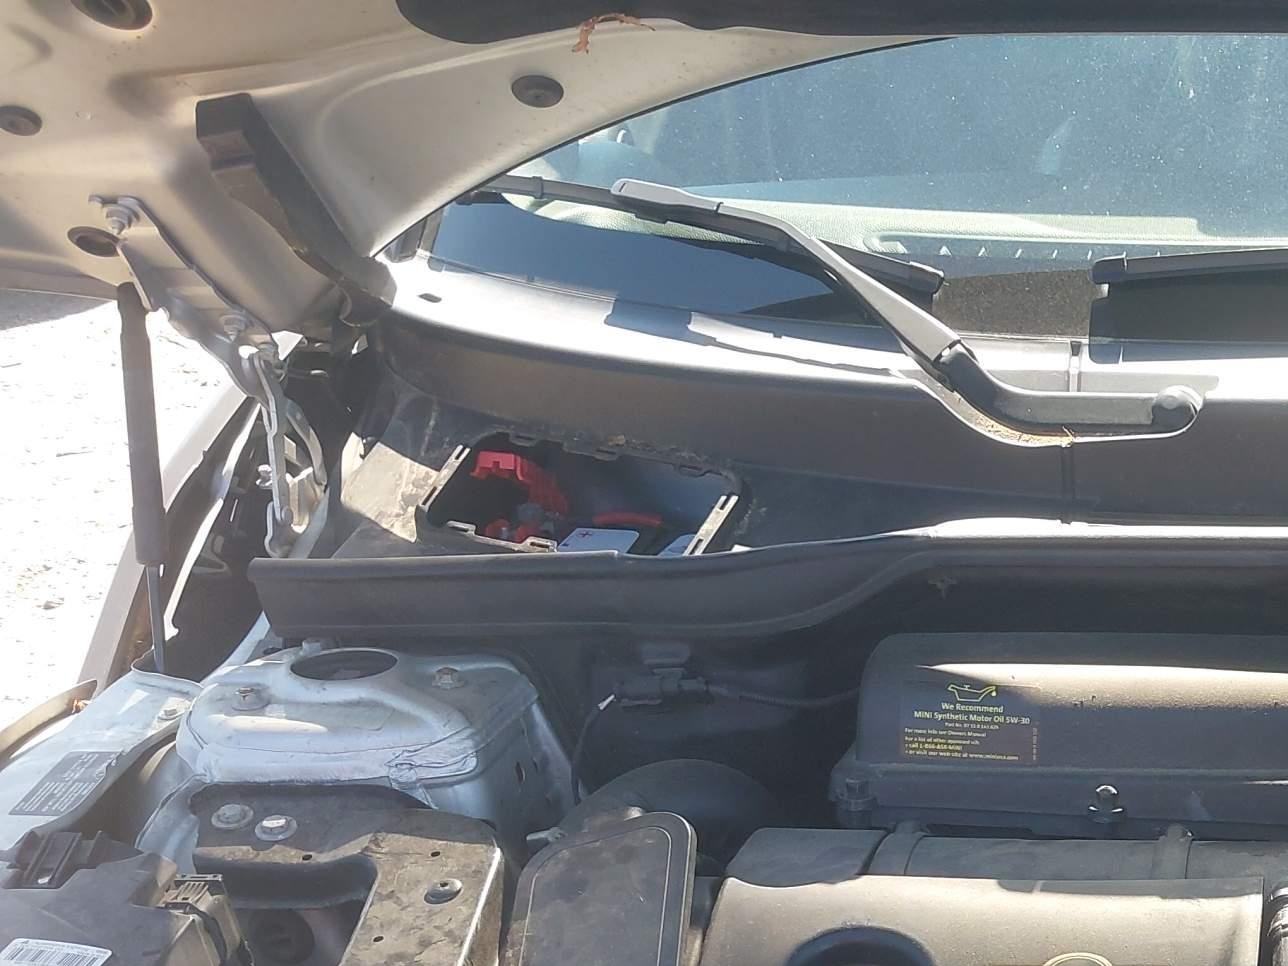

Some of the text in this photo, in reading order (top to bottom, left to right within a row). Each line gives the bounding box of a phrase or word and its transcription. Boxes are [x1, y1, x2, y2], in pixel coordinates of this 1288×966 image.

[941, 702, 1004, 713] We Recommend
[934, 712, 968, 721] Synthetic
[1005, 716, 1030, 724] 5W-30
